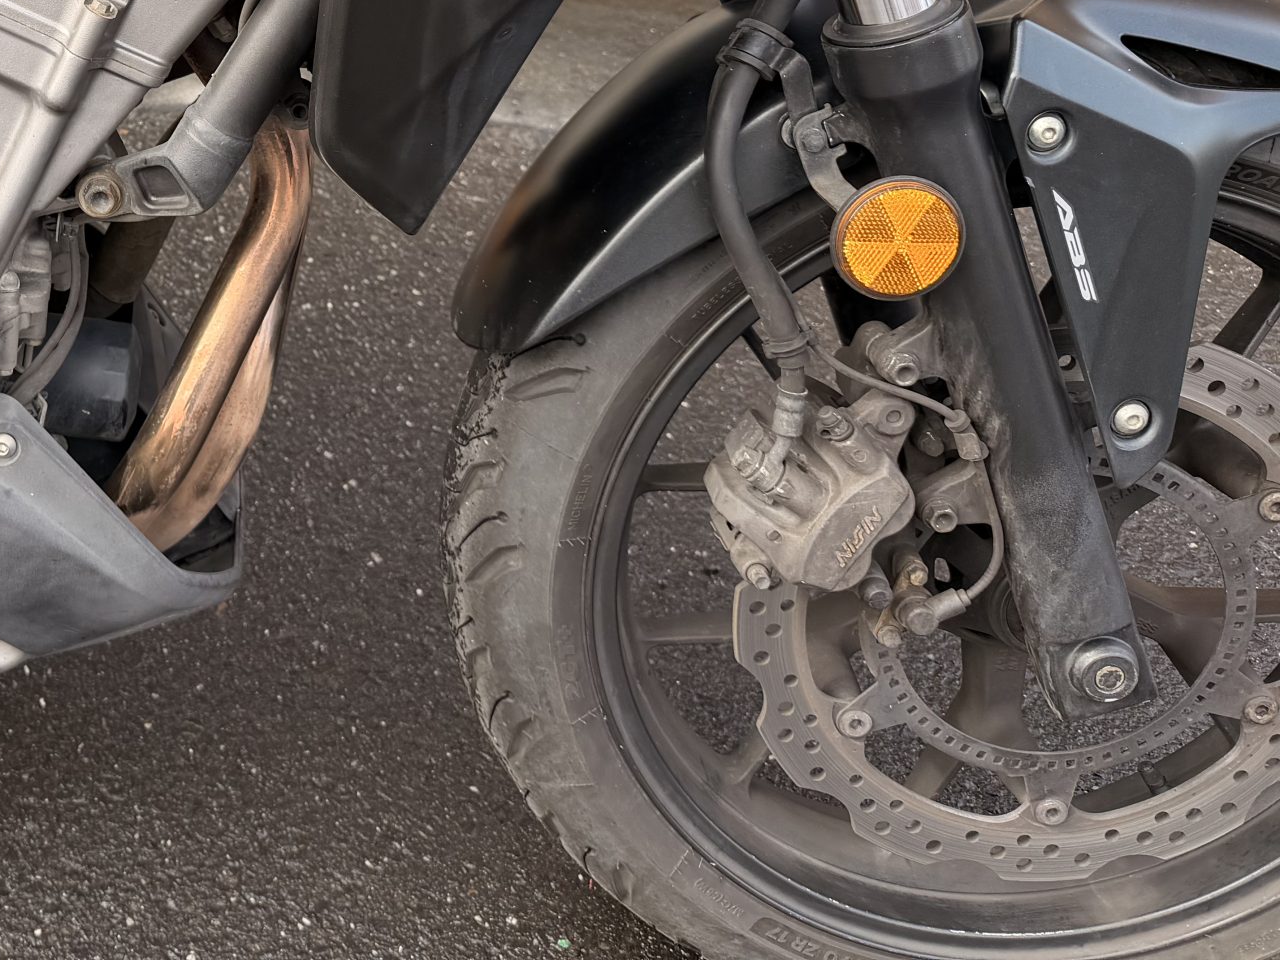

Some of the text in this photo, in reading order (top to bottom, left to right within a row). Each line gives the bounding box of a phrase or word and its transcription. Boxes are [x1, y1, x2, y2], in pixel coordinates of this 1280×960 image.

[1051, 188, 1098, 302] ABS
[568, 474, 595, 531] MICHELIN
[765, 925, 787, 941] 17
